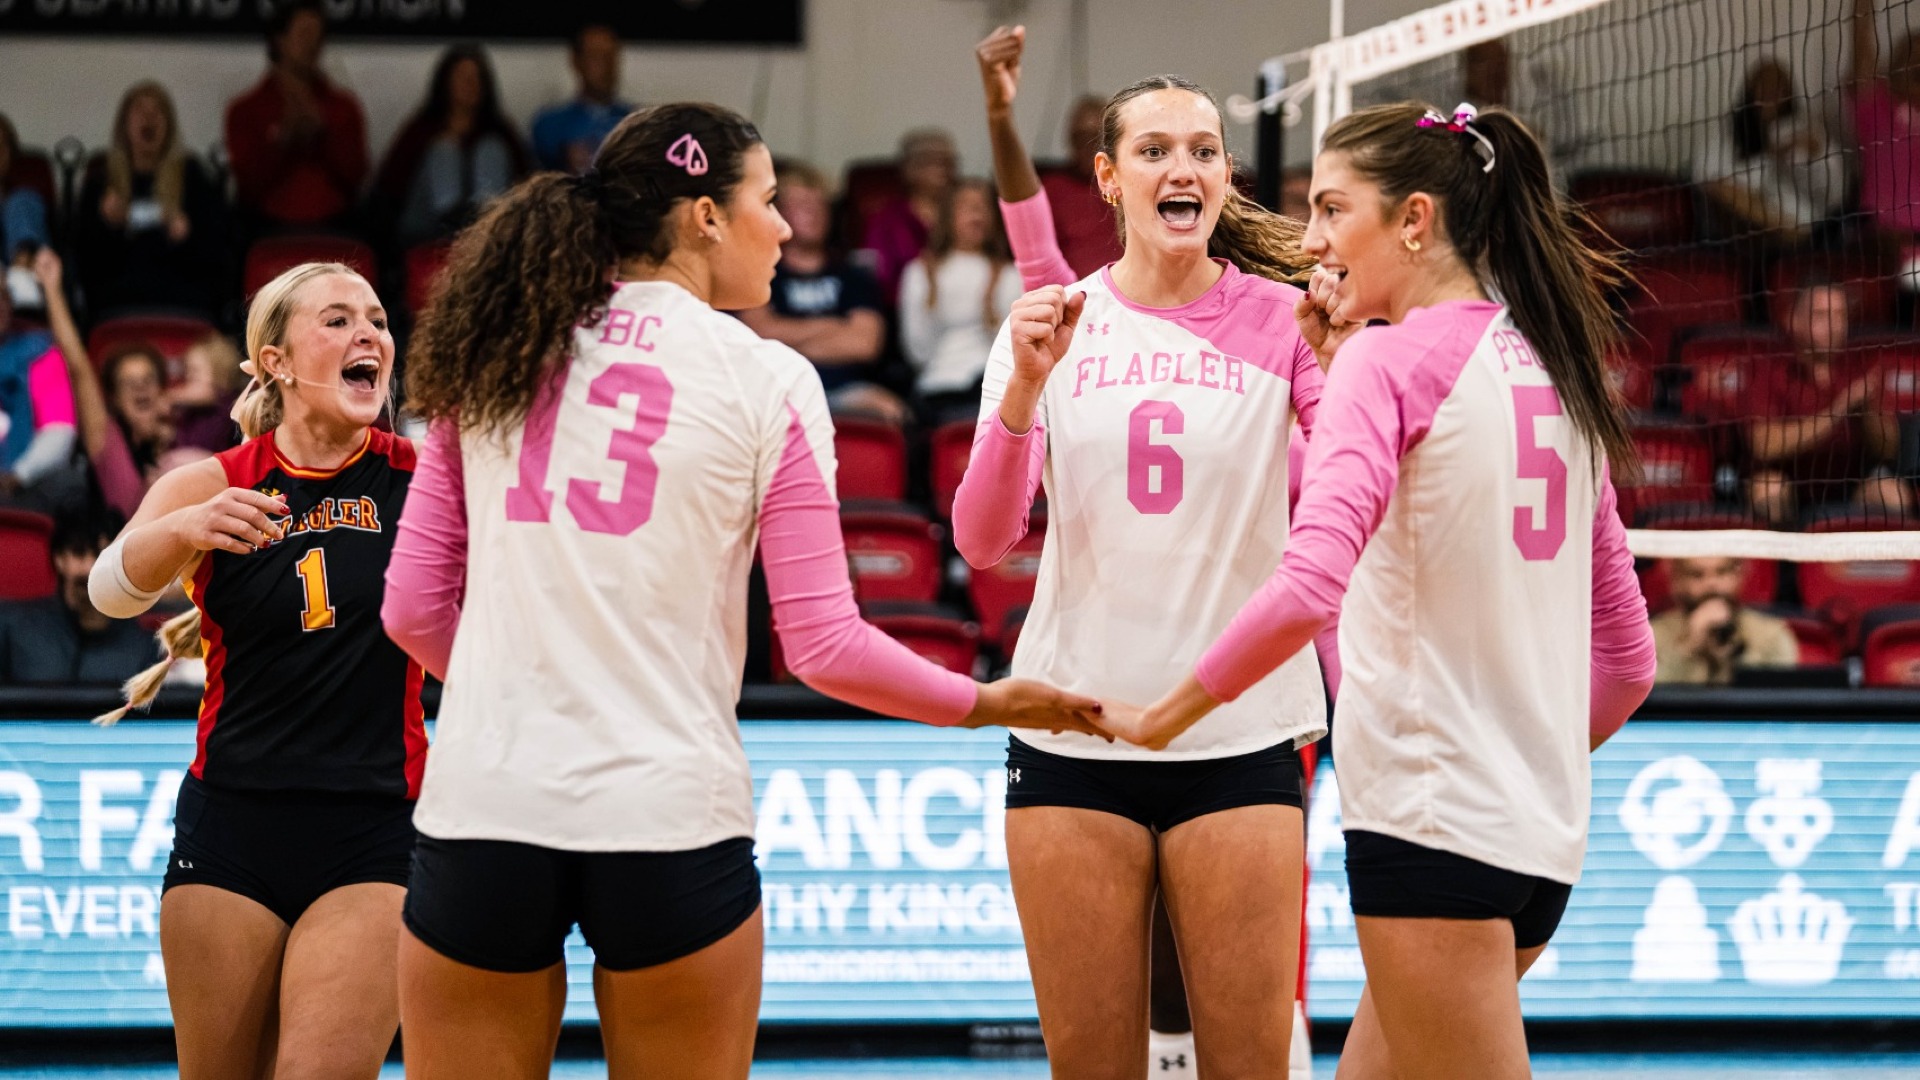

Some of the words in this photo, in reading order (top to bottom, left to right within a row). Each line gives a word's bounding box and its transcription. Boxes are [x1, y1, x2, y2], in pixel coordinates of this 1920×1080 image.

[576, 306, 662, 352] BC
[1072, 350, 1245, 398] FLAGLER
[505, 362, 674, 537] 13
[1127, 400, 1185, 515] 6
[1511, 385, 1567, 561] 5
[295, 547, 335, 632] 1
[9, 886, 165, 939] EVER
